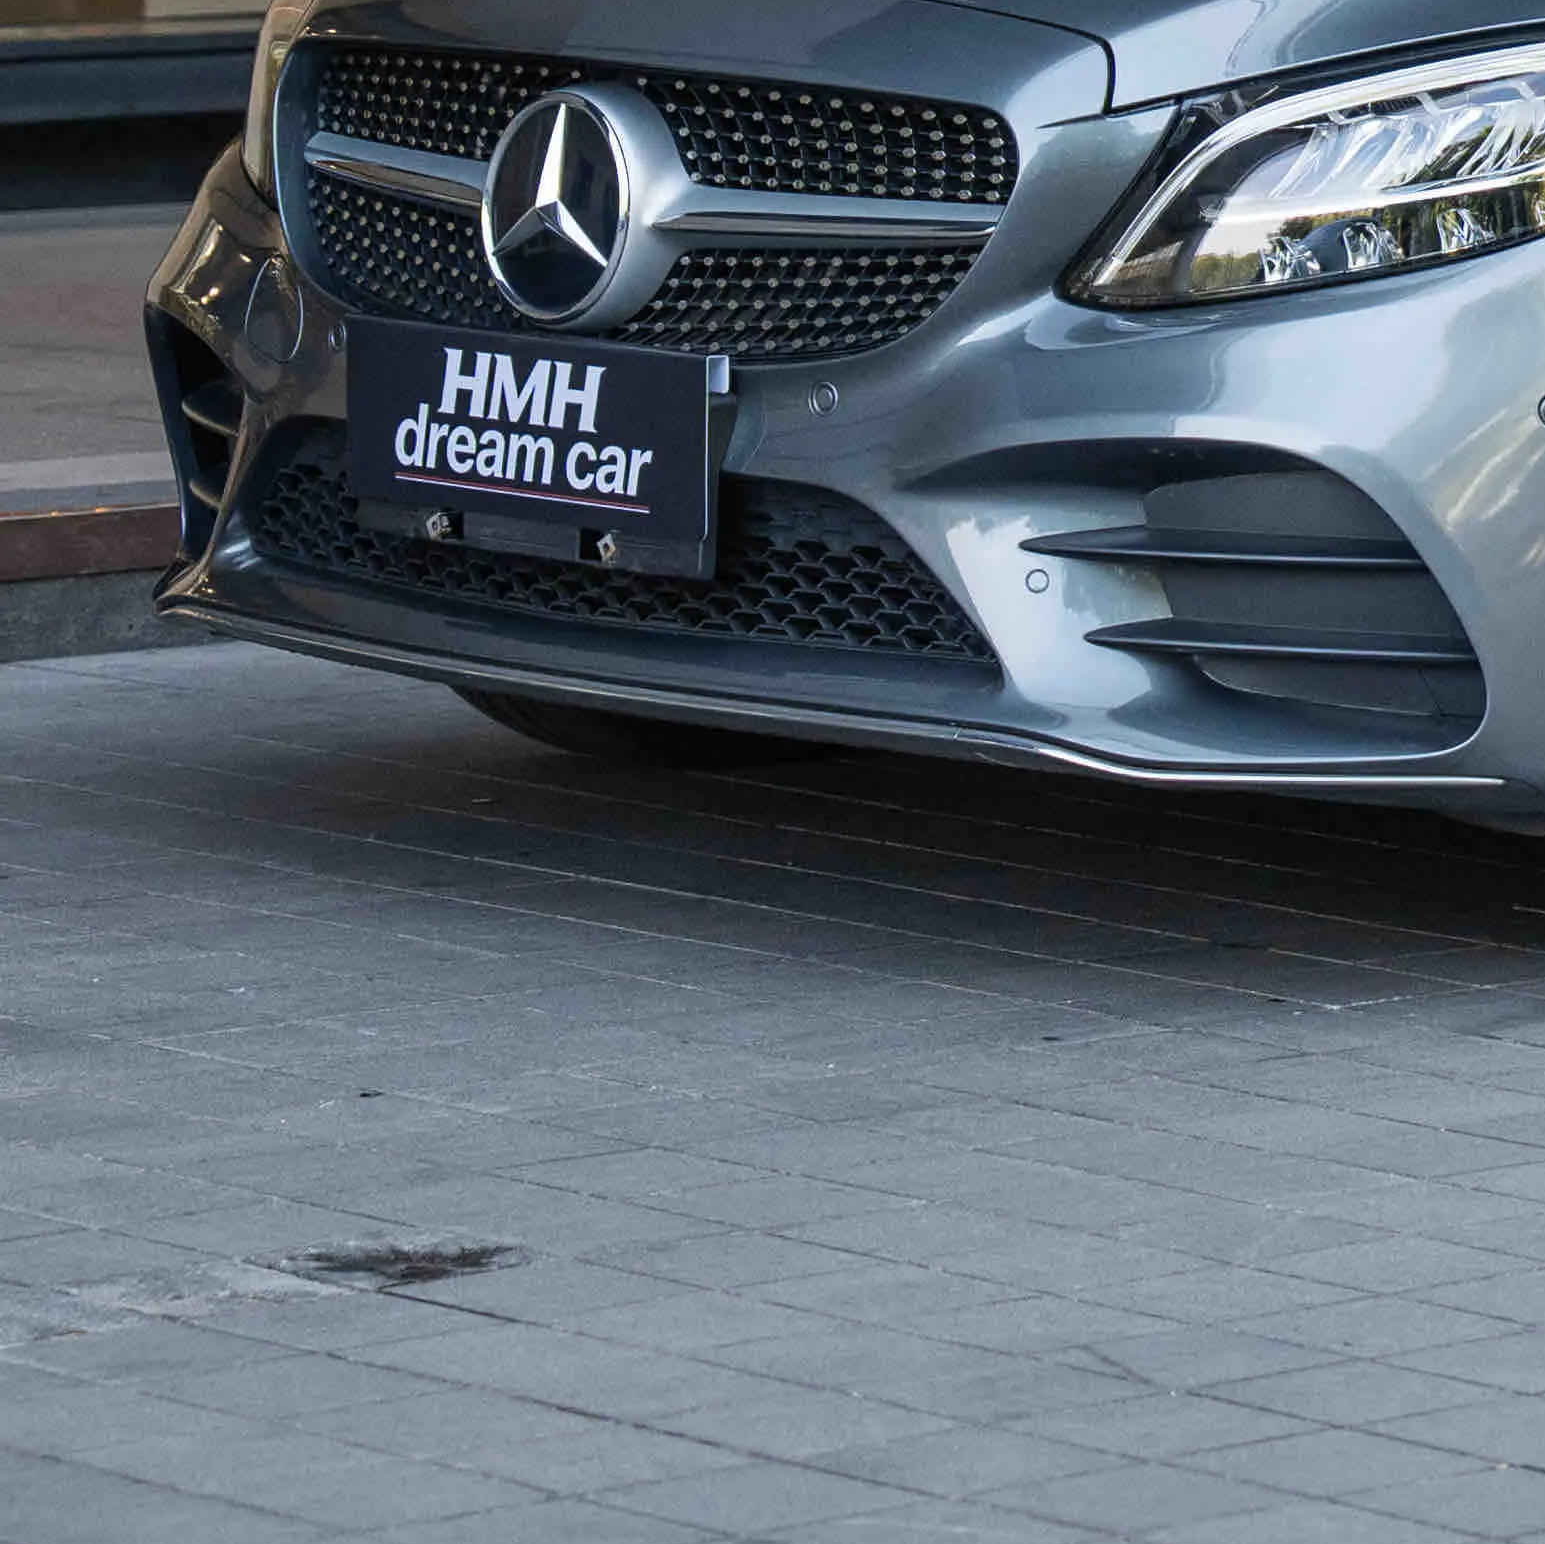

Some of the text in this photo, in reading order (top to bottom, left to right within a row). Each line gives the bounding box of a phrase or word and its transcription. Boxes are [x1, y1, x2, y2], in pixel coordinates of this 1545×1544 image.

[437, 347, 607, 434] HMH
[394, 402, 653, 497] dream car
